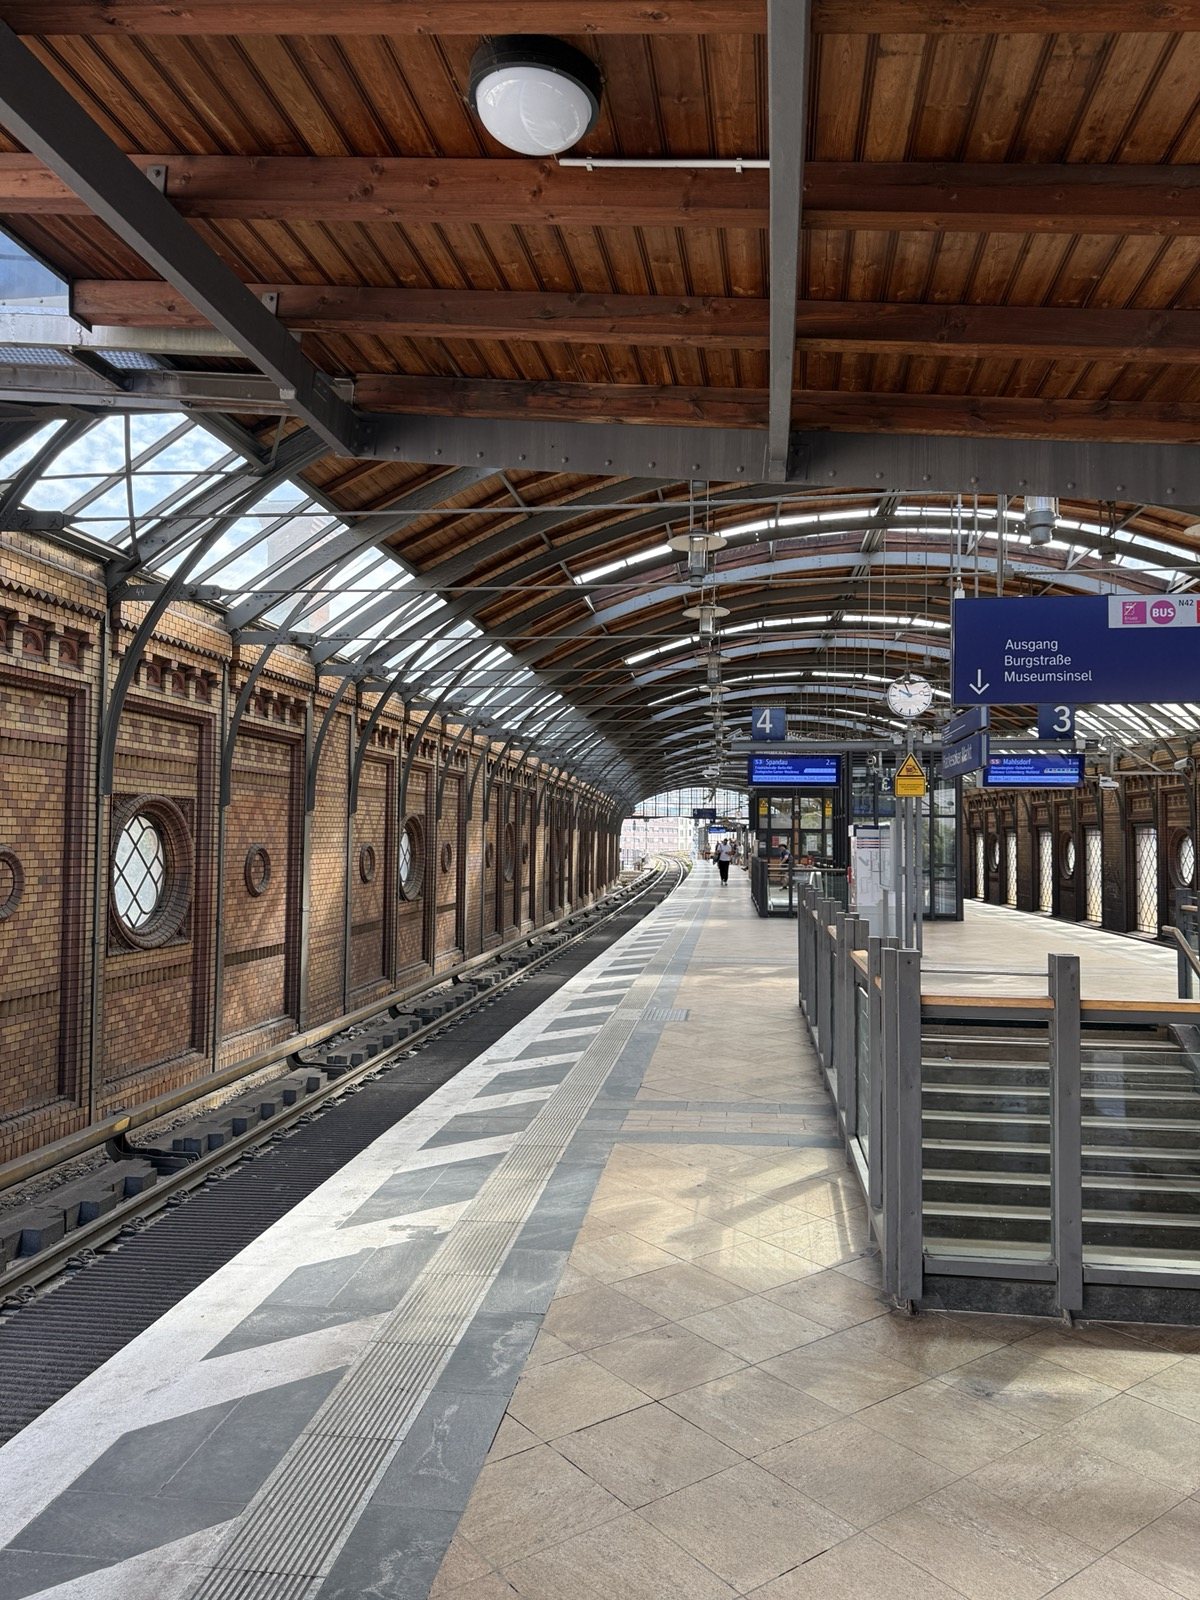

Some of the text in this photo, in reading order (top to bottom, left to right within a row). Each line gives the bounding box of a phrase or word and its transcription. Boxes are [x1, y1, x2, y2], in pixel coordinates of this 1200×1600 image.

[1178, 599, 1194, 607] N42
[1152, 608, 1175, 618] BUS
[1005, 639, 1058, 652] Ausgang
[1004, 654, 1072, 668] Burgstraße
[1004, 670, 1093, 682] Museumsinsel
[756, 709, 773, 734] 4
[1053, 705, 1071, 732] 3
[766, 758, 788, 767] Spandau
[1003, 758, 1031, 766] Mahlsdorf
